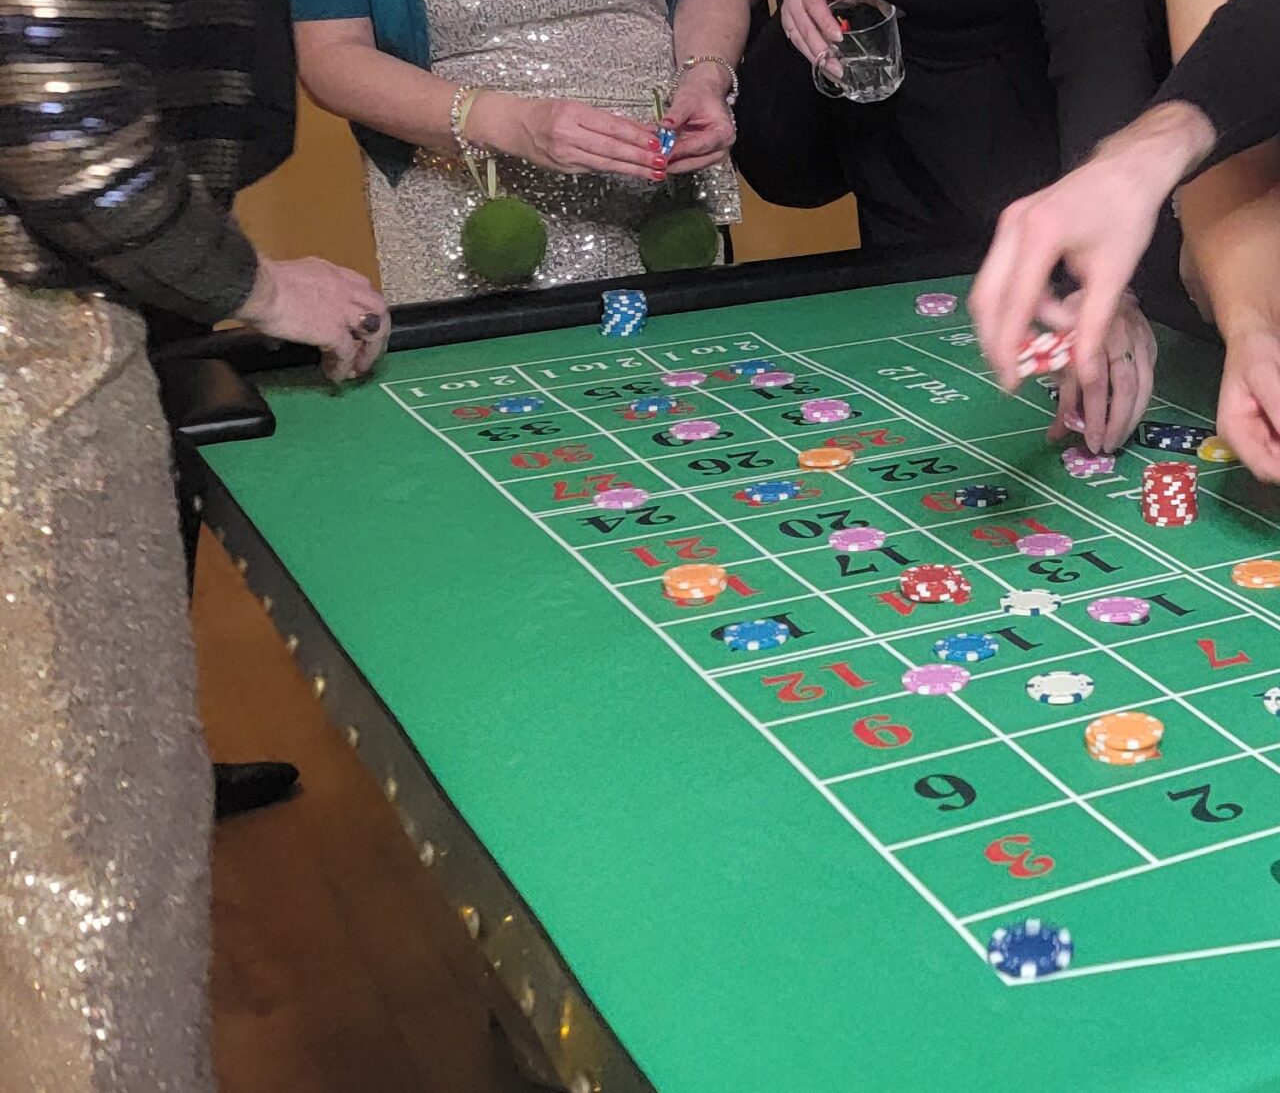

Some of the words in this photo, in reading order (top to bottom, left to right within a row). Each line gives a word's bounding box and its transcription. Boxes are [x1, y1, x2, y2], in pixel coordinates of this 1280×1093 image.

[662, 351, 684, 362] 1
[691, 344, 728, 356] to
[733, 340, 760, 351] 2
[539, 368, 560, 380] 1
[569, 361, 611, 373] to
[615, 357, 643, 369] 2
[877, 365, 929, 381] 12
[410, 386, 431, 398] 1
[440, 380, 482, 391] to
[489, 374, 517, 387] 2
[583, 381, 660, 401] 35
[905, 380, 969, 404] 3rd
[478, 421, 561, 442] 33
[824, 428, 906, 451] 25
[511, 443, 594, 469] 30
[688, 450, 774, 475] 26
[868, 456, 958, 482] 22
[553, 473, 634, 500] 27
[577, 505, 676, 534] 24
[779, 509, 870, 538] 20
[972, 517, 1061, 547] 16
[624, 536, 719, 568] 21
[836, 544, 921, 577] 17
[1028, 550, 1123, 583] 13
[1197, 638, 1252, 669] 7
[761, 661, 876, 703] 12
[852, 714, 913, 749] 9
[914, 773, 977, 811] 6
[1166, 784, 1243, 823] 2
[984, 834, 1055, 878] 3
